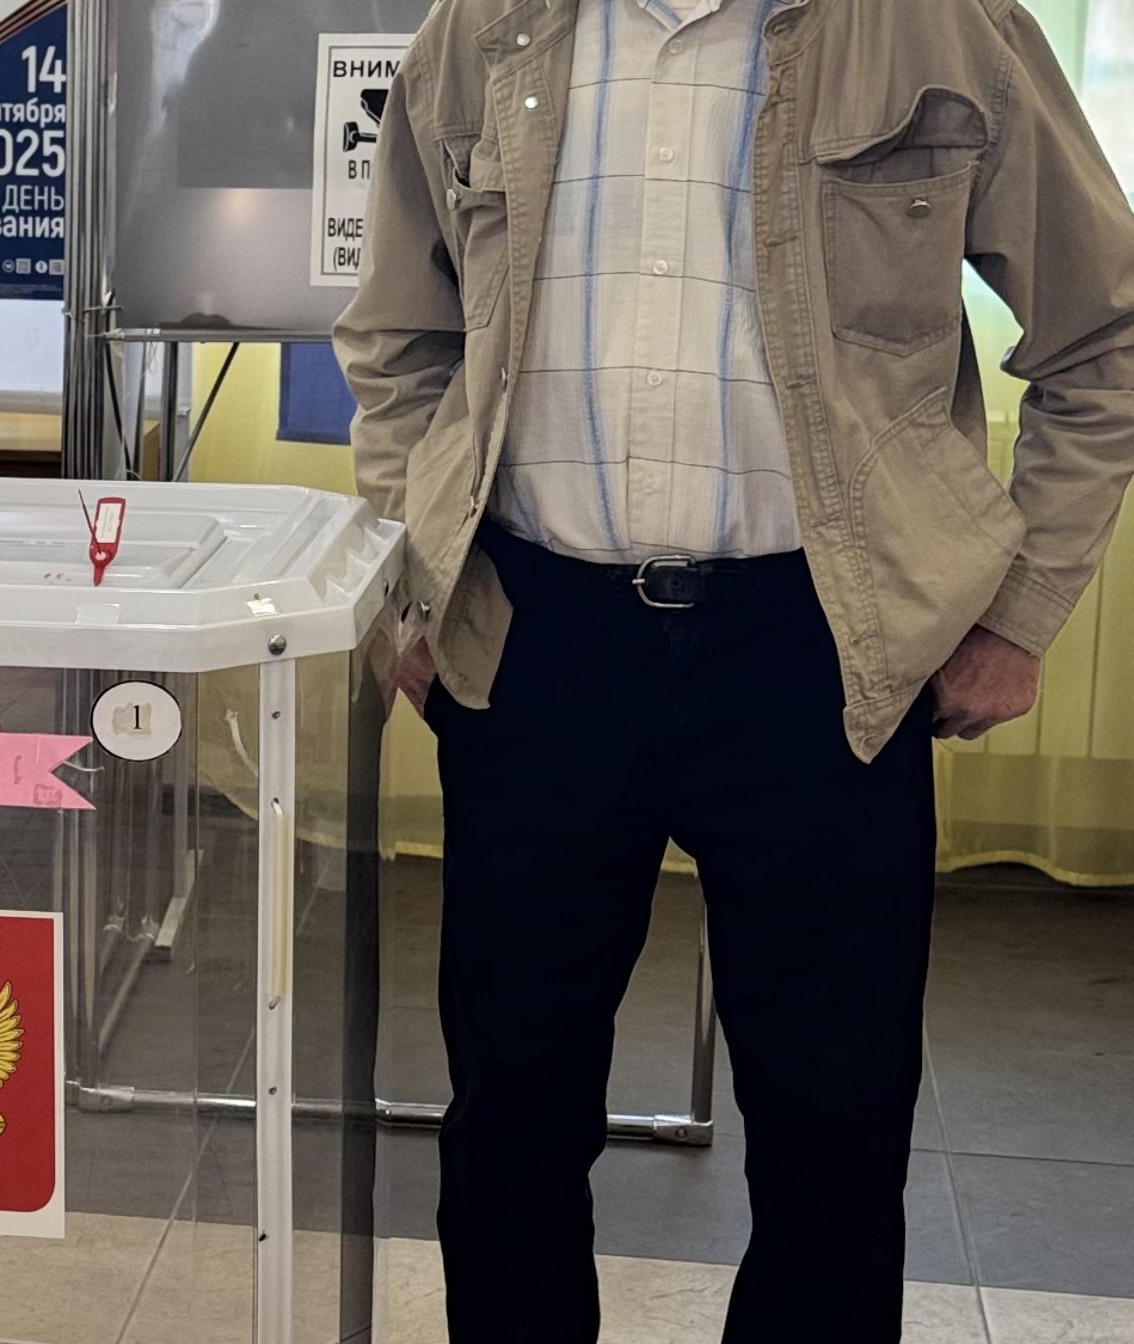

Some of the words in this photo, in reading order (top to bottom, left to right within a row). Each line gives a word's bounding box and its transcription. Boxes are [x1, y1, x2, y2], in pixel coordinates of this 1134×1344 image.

[21, 45, 66, 93] 14
[333, 59, 402, 79] ВНИМ
[348, 159, 357, 179] В
[2, 184, 65, 213] ДЕНЬ
[327, 217, 364, 242] ВИДЕ
